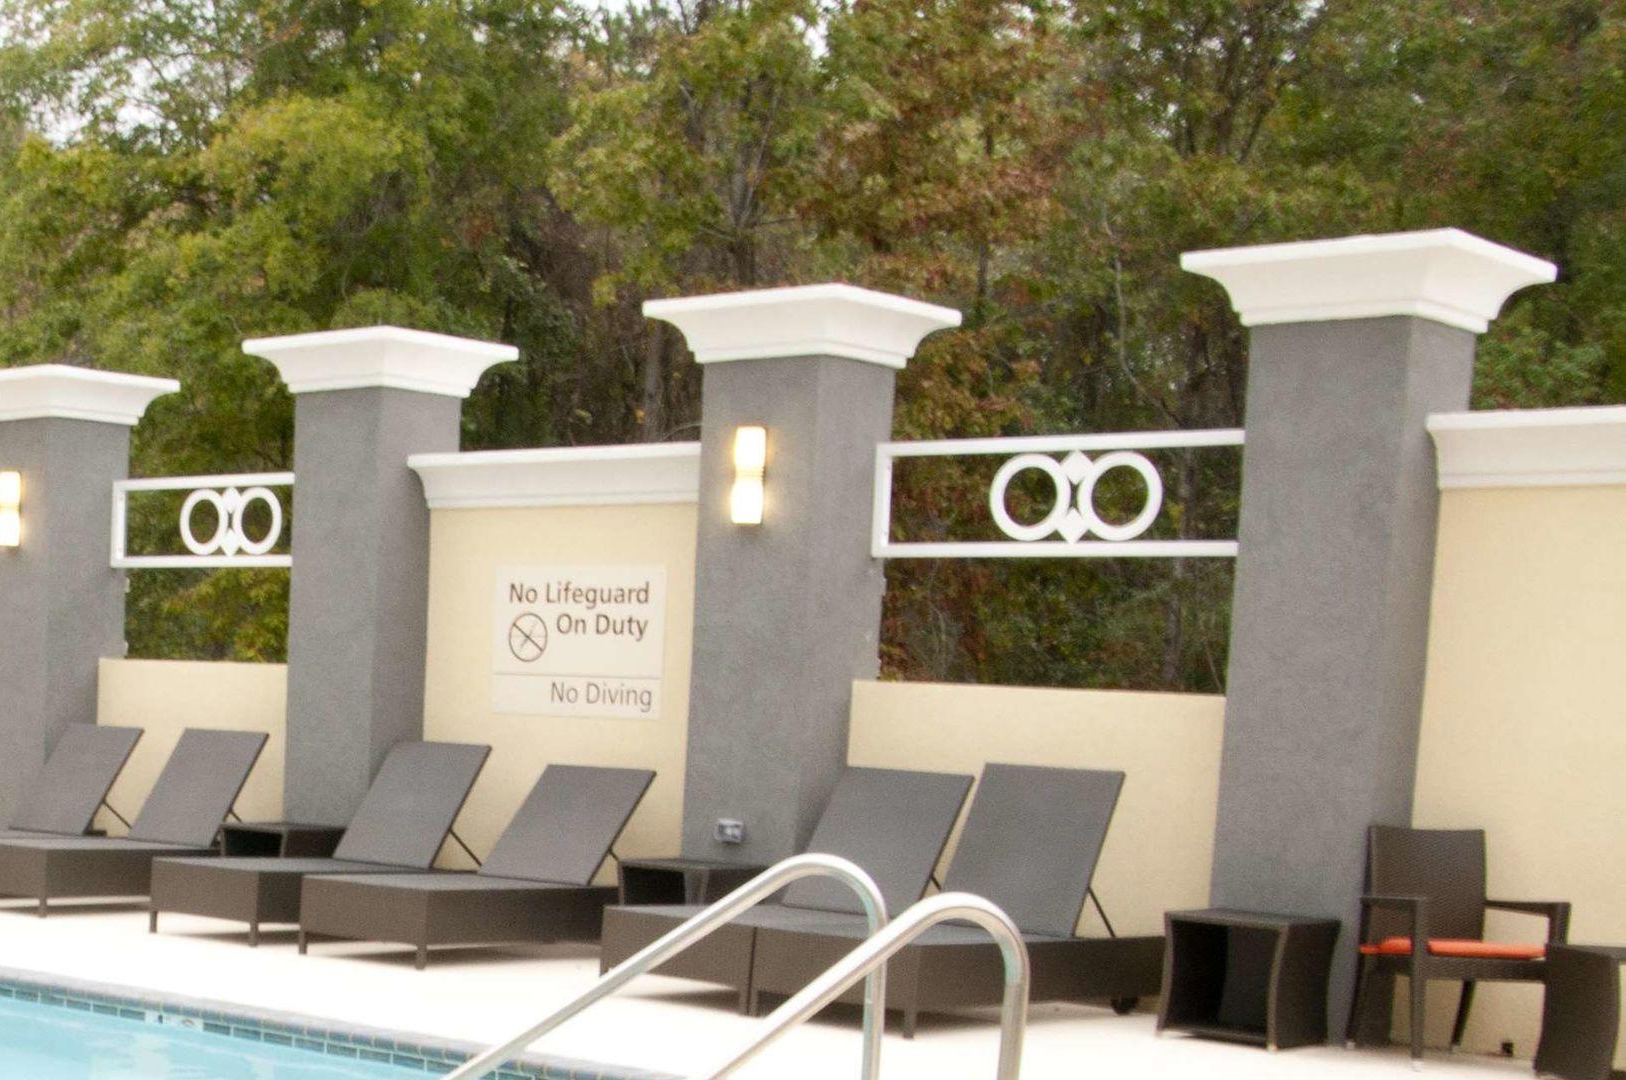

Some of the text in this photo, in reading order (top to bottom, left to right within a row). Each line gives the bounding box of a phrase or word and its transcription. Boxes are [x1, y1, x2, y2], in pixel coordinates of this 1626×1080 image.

[509, 581, 650, 610] No Lifeguard
[556, 613, 649, 642] On Duty
[550, 682, 652, 713] No Diving
